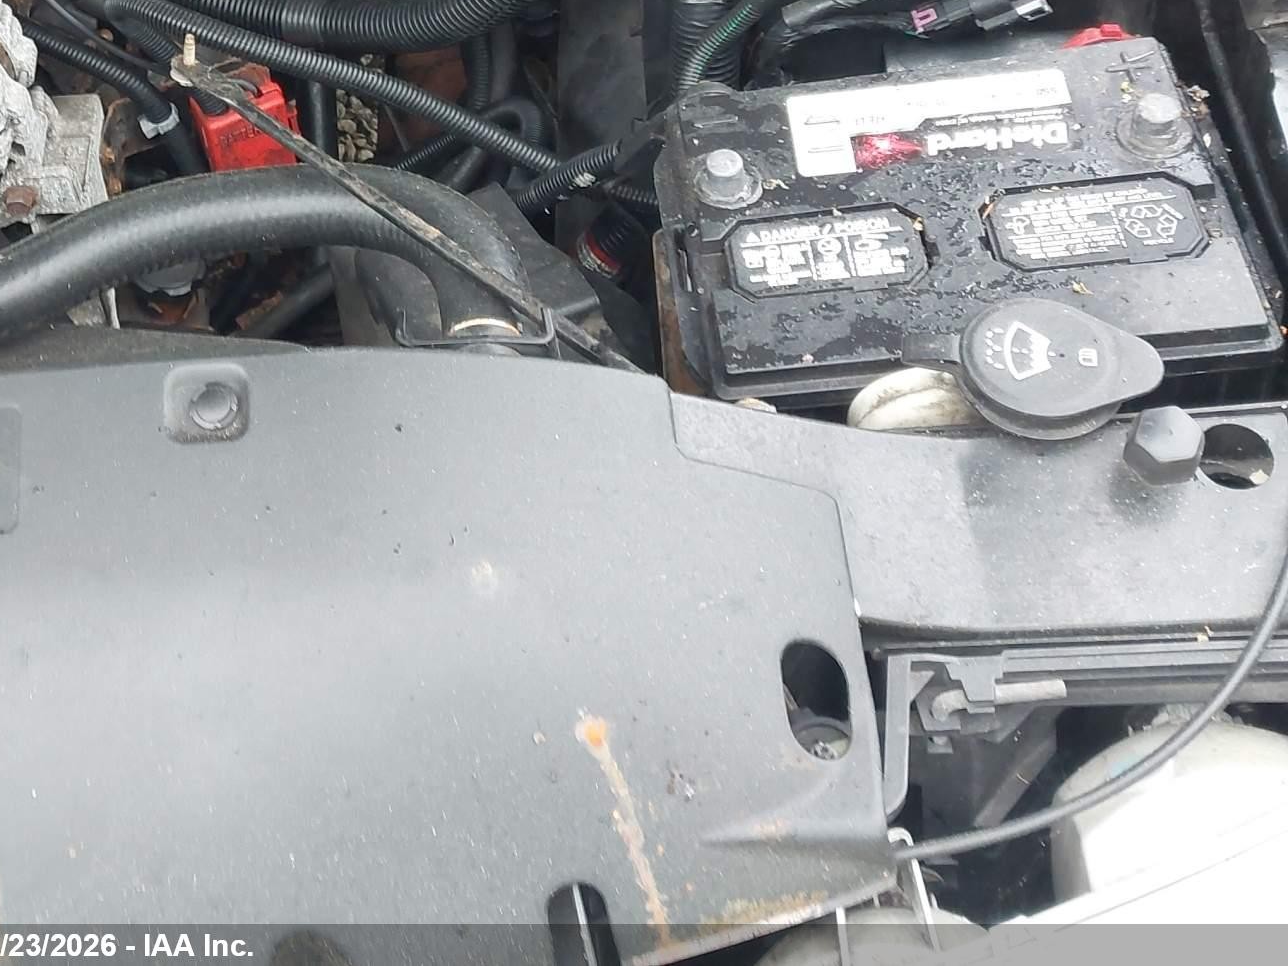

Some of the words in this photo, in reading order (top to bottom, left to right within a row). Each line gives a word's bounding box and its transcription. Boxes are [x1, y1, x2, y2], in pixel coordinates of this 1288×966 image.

[927, 121, 1068, 156] DieHard
[760, 224, 820, 242] DANGER
[834, 217, 890, 233] POISON
